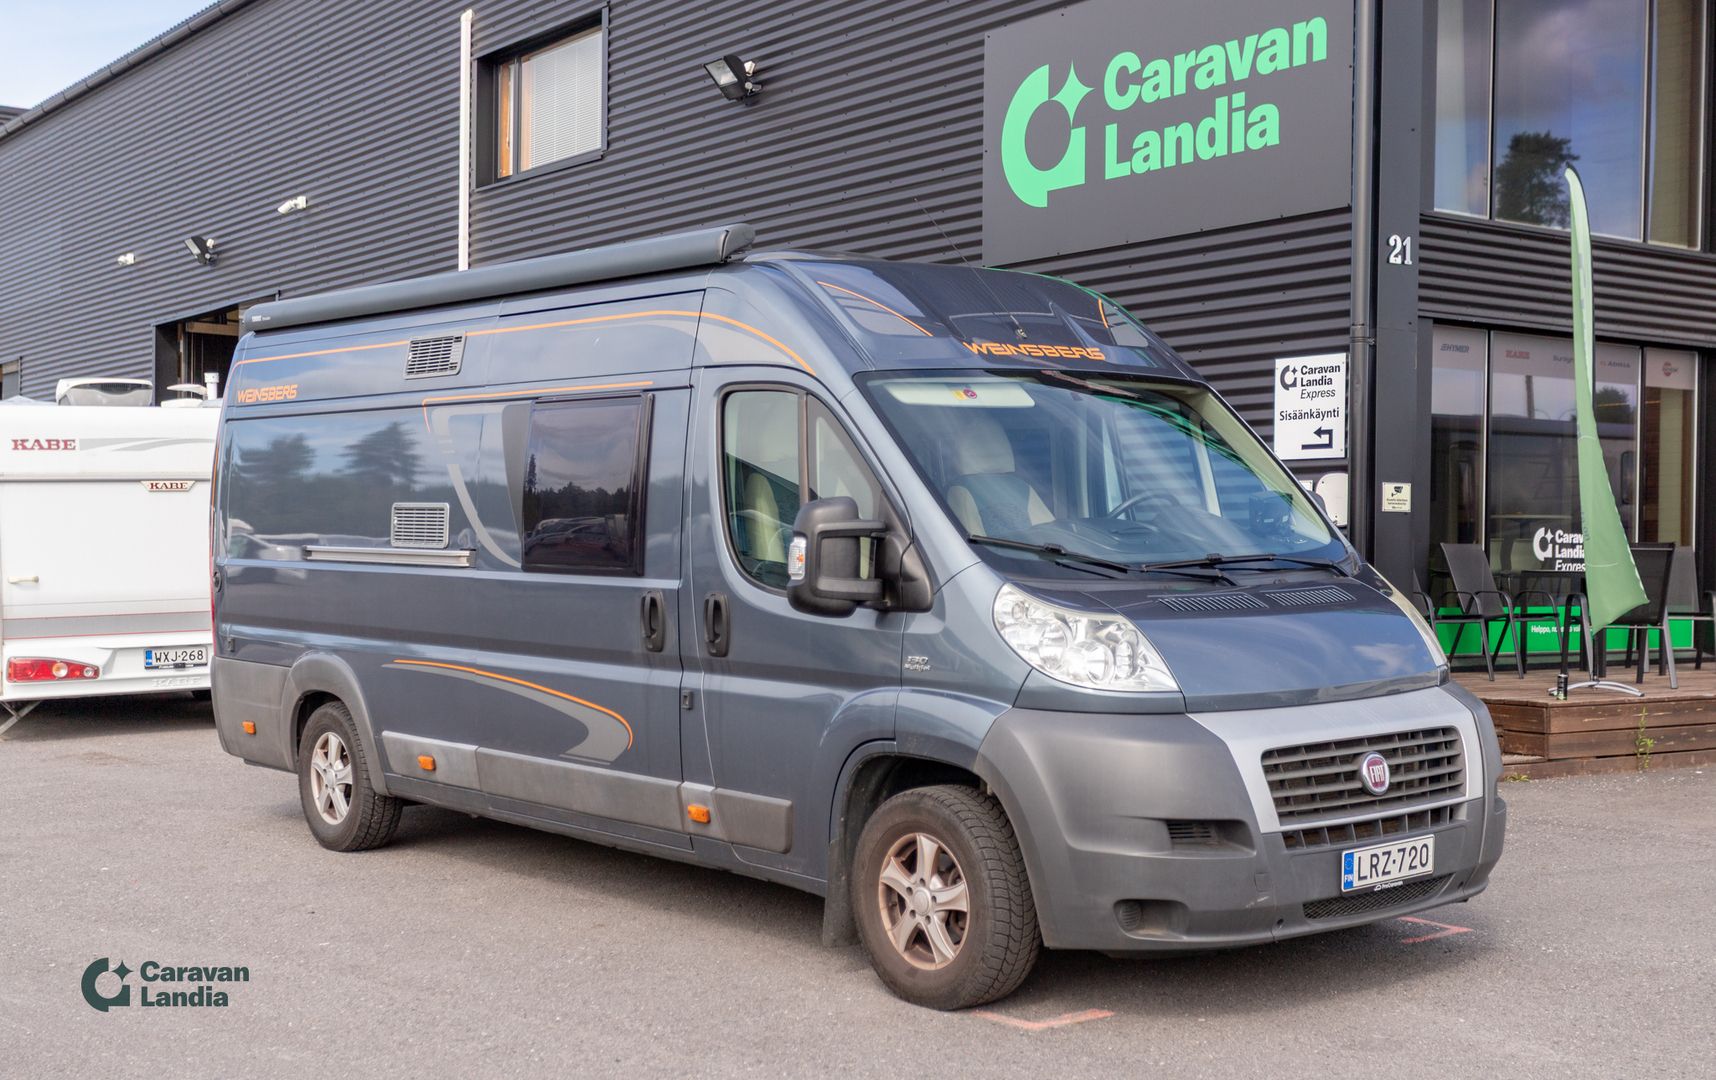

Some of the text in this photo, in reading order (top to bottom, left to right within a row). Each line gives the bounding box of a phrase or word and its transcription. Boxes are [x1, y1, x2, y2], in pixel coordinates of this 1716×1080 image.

[1104, 16, 1327, 111] Caravan
[1104, 91, 1280, 180] Landia
[1389, 234, 1412, 265] 21
[962, 341, 1106, 361] WEINSBERG
[1300, 364, 1341, 376] Caravan
[1300, 375, 1333, 387] Landia
[237, 384, 298, 403] WEINSBERG
[1300, 388, 1336, 401] Express
[1279, 407, 1340, 421] Sisäänkäynti
[11, 439, 76, 451] KABE
[149, 482, 188, 490] KABE
[1555, 529, 1584, 544] Carav
[1554, 559, 1587, 572] Expres
[154, 650, 204, 663] WXJ-268
[1369, 765, 1385, 784] FIAT
[1357, 843, 1429, 882] LRZ-720
